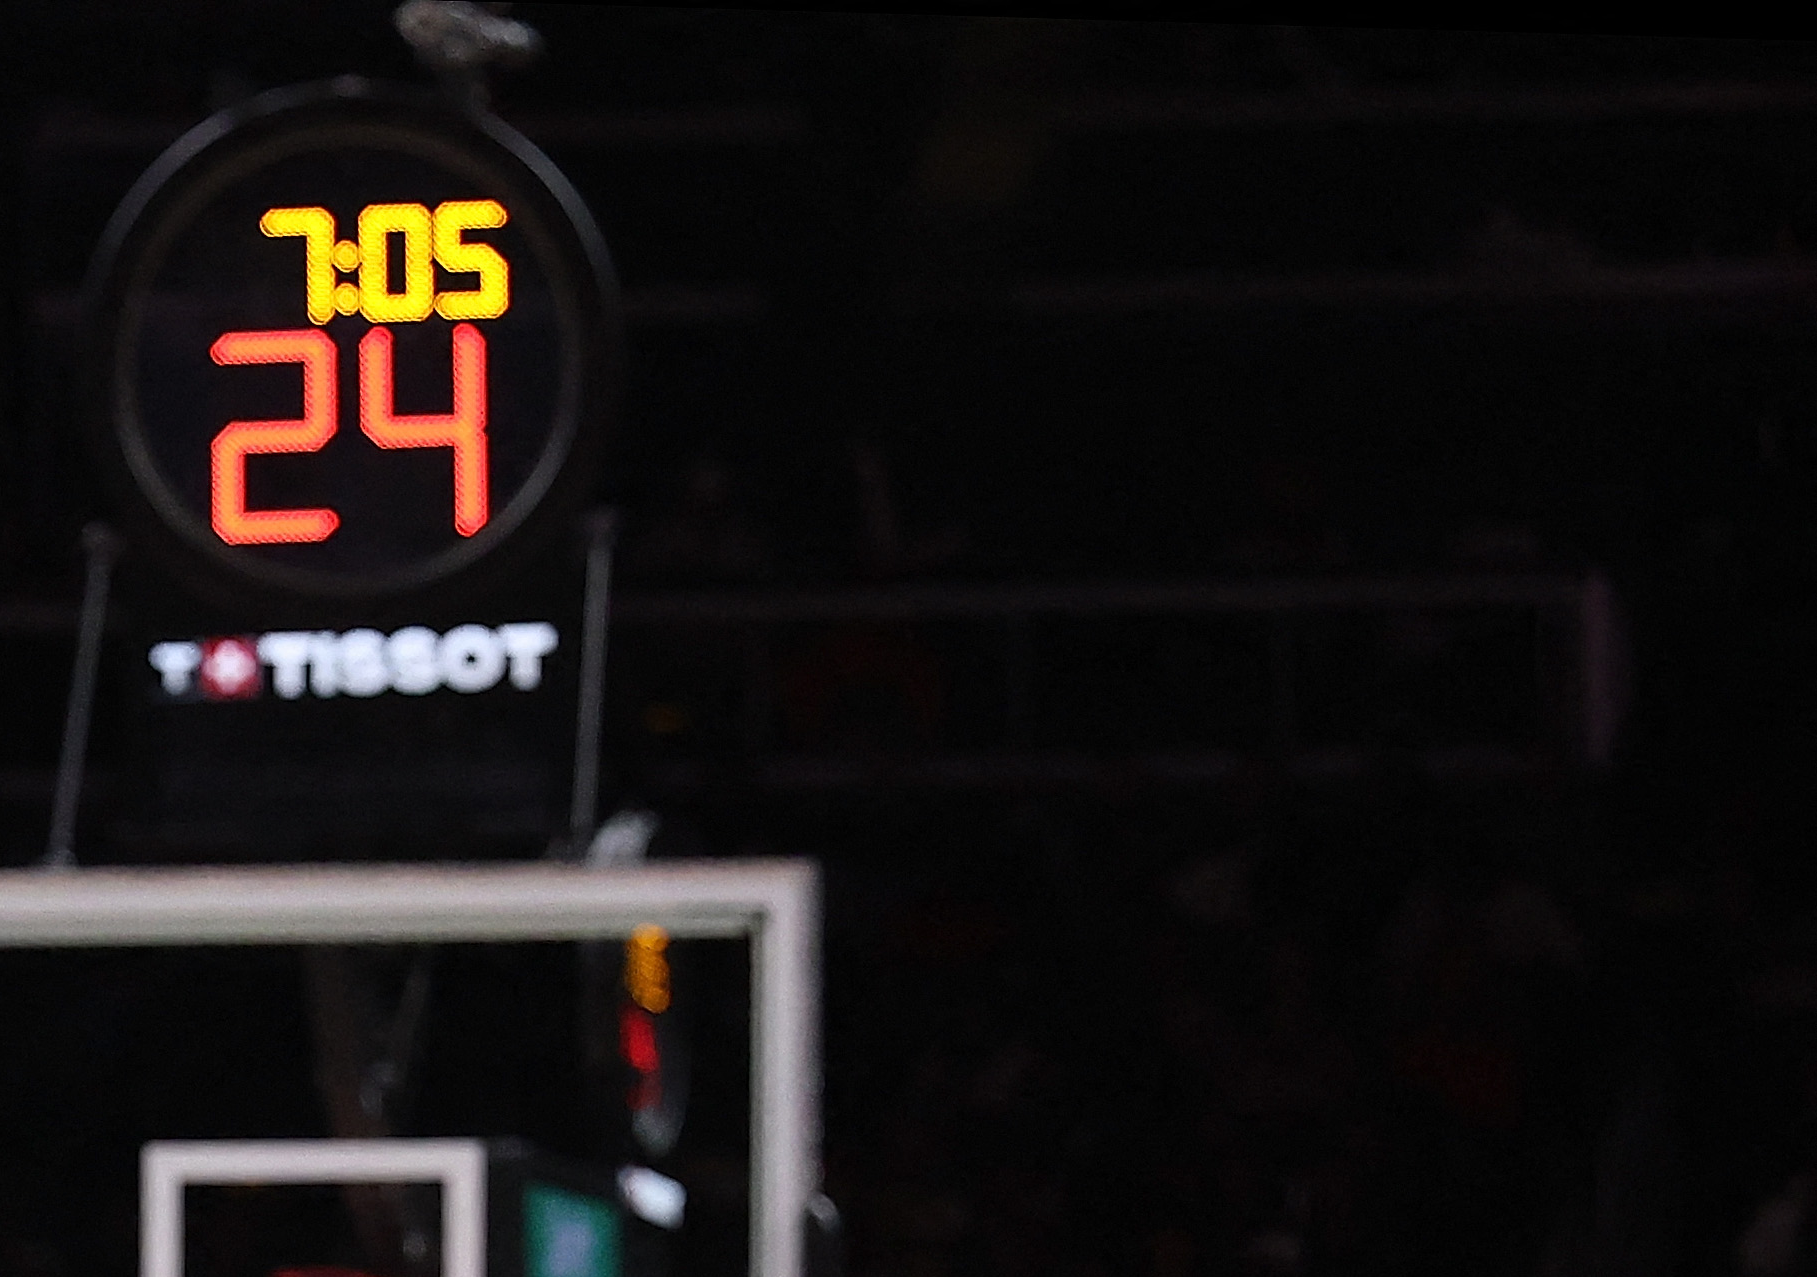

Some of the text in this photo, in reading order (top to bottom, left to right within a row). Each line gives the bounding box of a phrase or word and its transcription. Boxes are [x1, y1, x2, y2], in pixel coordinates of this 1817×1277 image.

[259, 200, 508, 324] 7:05
[210, 323, 489, 545] 24
[258, 621, 559, 697] TISSOT
